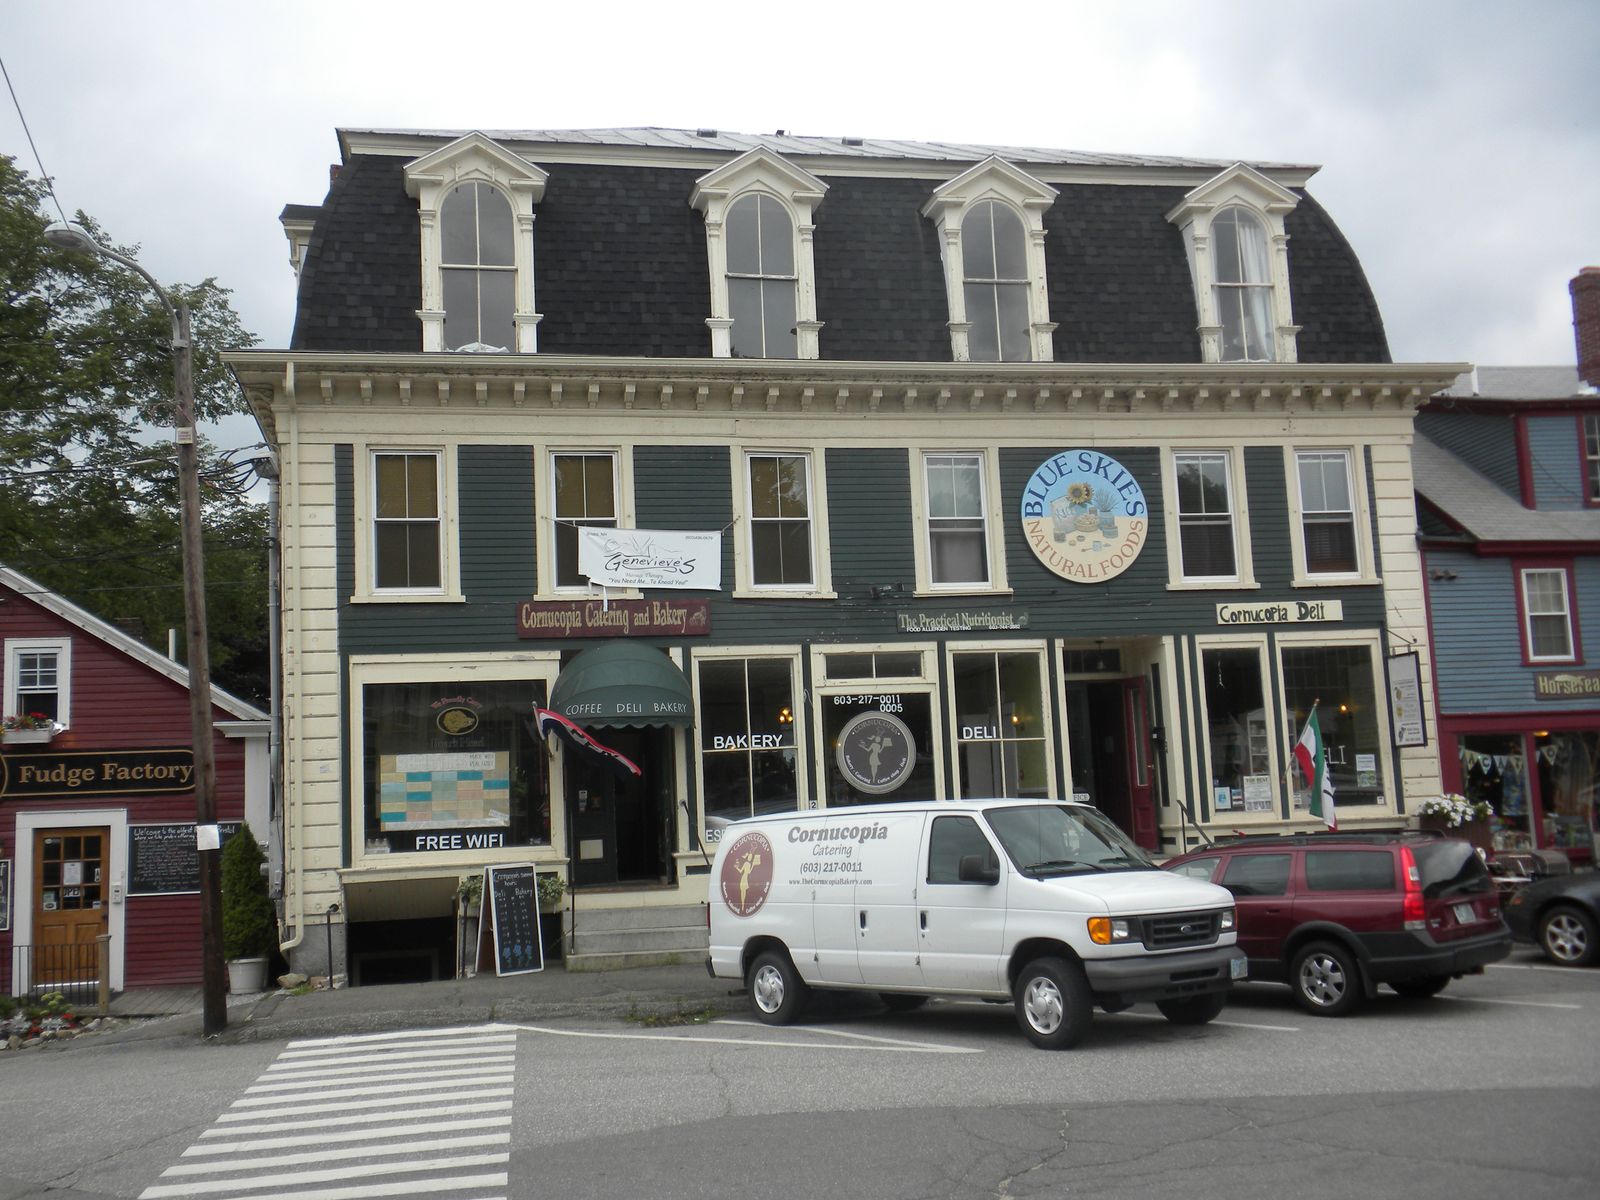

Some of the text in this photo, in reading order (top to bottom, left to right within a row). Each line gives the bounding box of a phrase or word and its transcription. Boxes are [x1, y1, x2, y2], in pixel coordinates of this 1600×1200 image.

[1025, 452, 1145, 518] BLUE SKIES
[1027, 520, 1143, 578] NATURAL FOODS
[521, 603, 582, 636] Cornucopia
[633, 608, 650, 626] and
[652, 601, 688, 633] Bakery
[898, 611, 1014, 628] The Practical Nutritionist
[1219, 601, 1326, 623] Cornucopia Deli
[833, 694, 901, 705] 603-217-0011
[565, 702, 688, 715] COFFEE DELI BAKERY
[879, 704, 904, 713] 0005
[853, 719, 898, 735] CORNUCOPIA
[962, 726, 997, 739] DELI
[713, 734, 783, 749] BAKERY
[18, 763, 194, 787] Fudge Factory
[133, 827, 161, 837] Welcome
[787, 822, 888, 844] Cornucopia
[415, 833, 504, 851] FREE WIFI
[812, 843, 853, 858] Catering
[799, 861, 863, 873] (603) 217-0011
